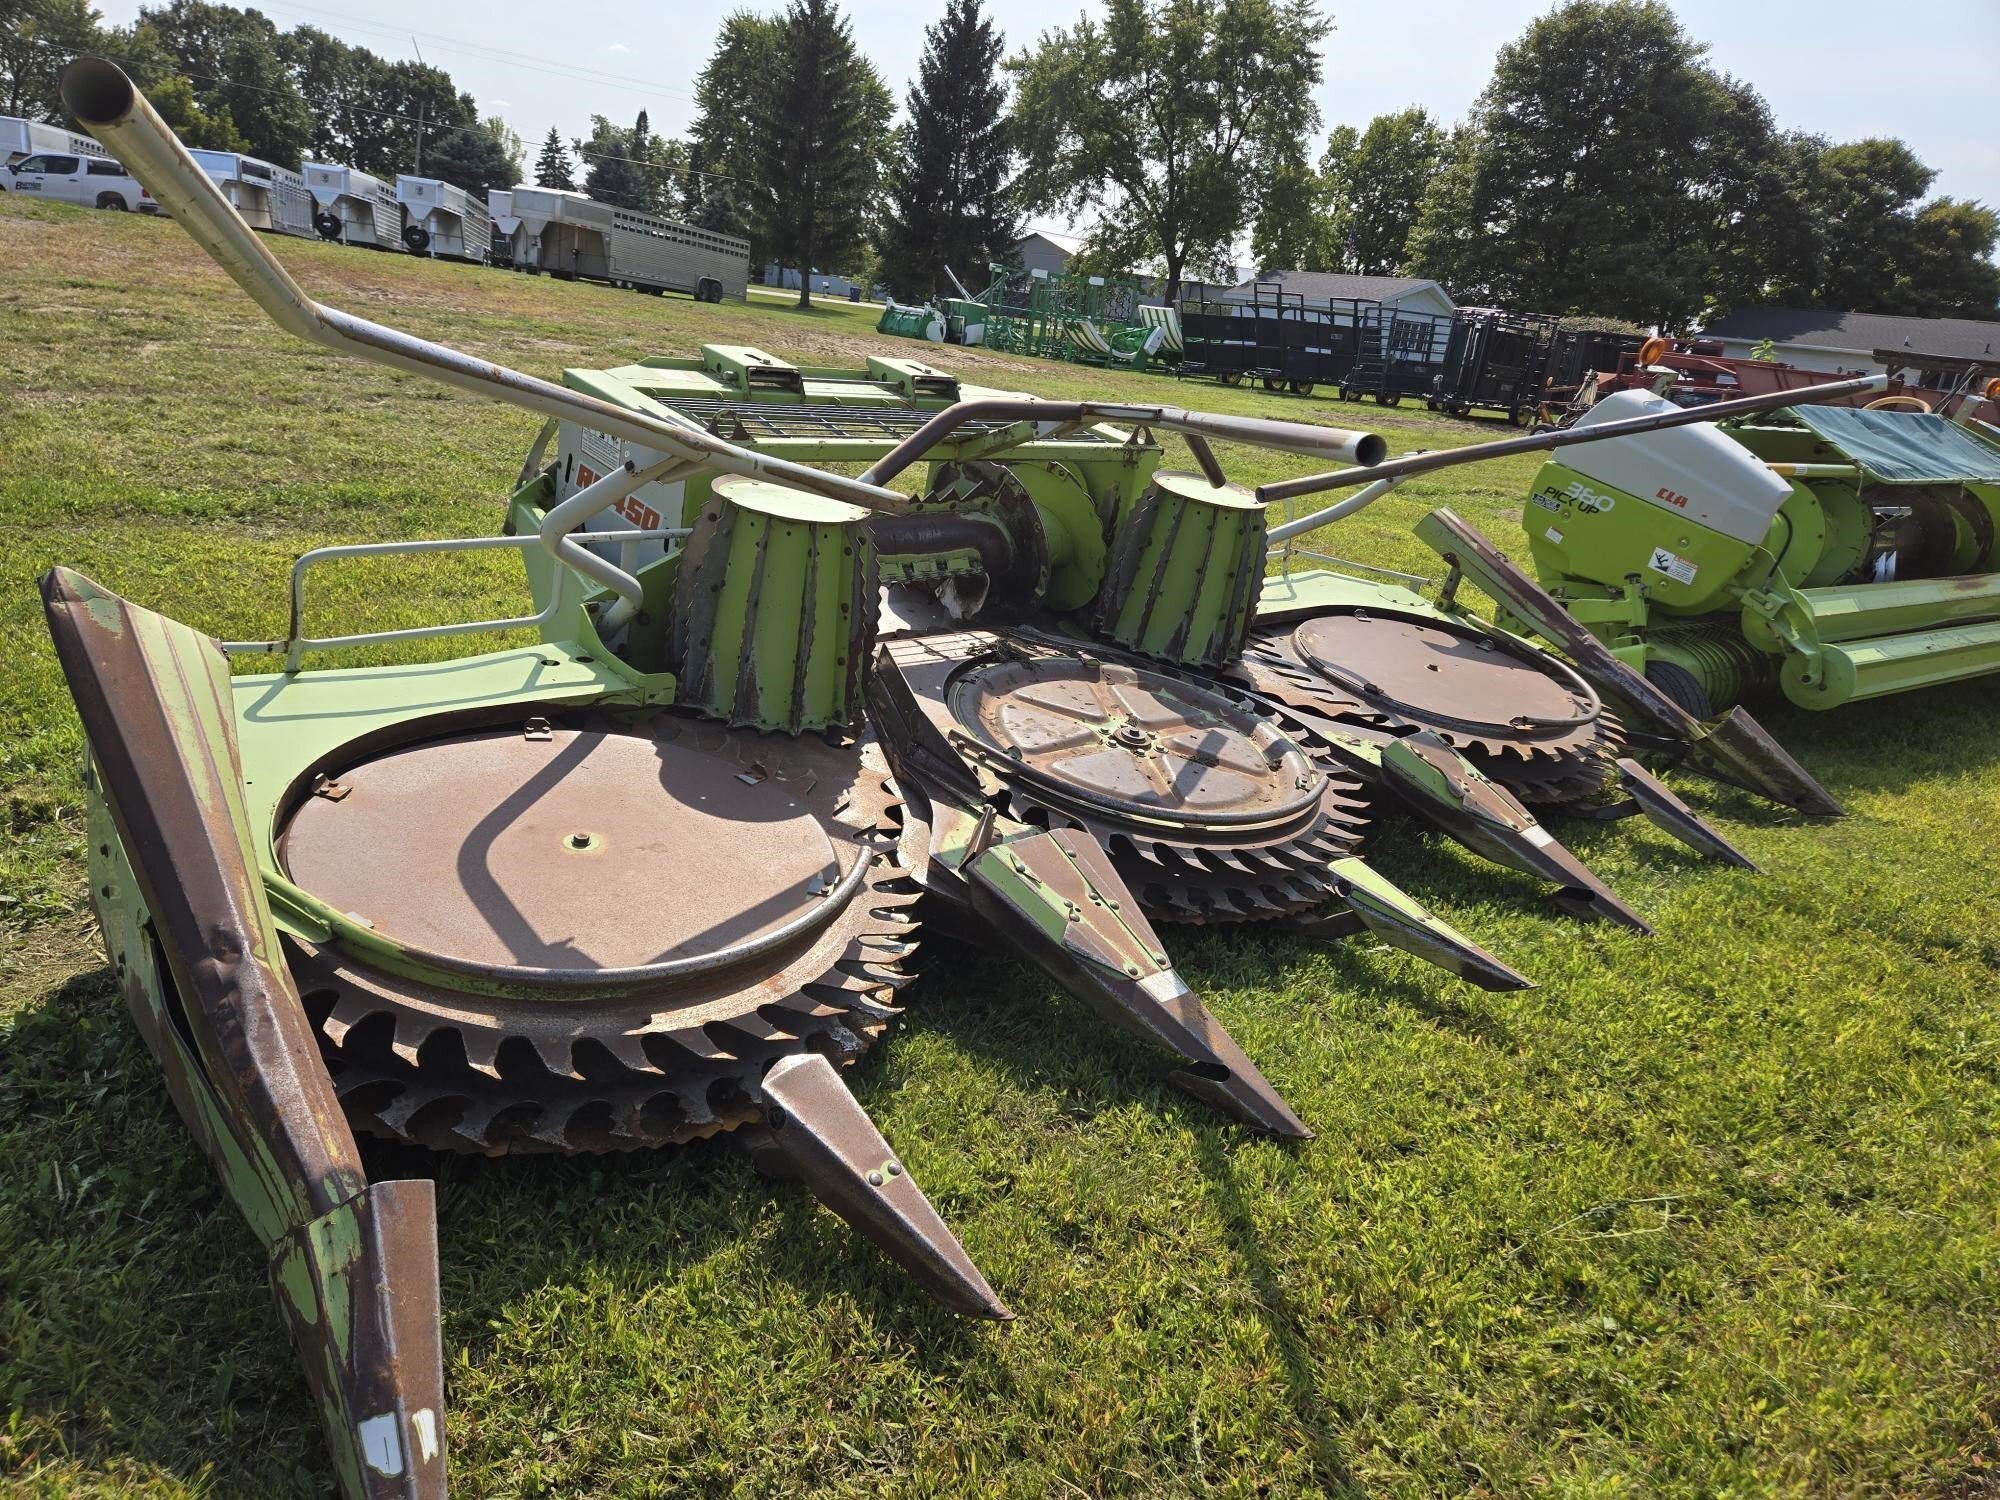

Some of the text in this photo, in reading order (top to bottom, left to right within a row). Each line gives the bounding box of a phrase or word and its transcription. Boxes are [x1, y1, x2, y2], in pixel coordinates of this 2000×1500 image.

[1543, 486, 1577, 507] PICK
[1577, 501, 1600, 514] UP
[1565, 481, 1616, 512] 360
